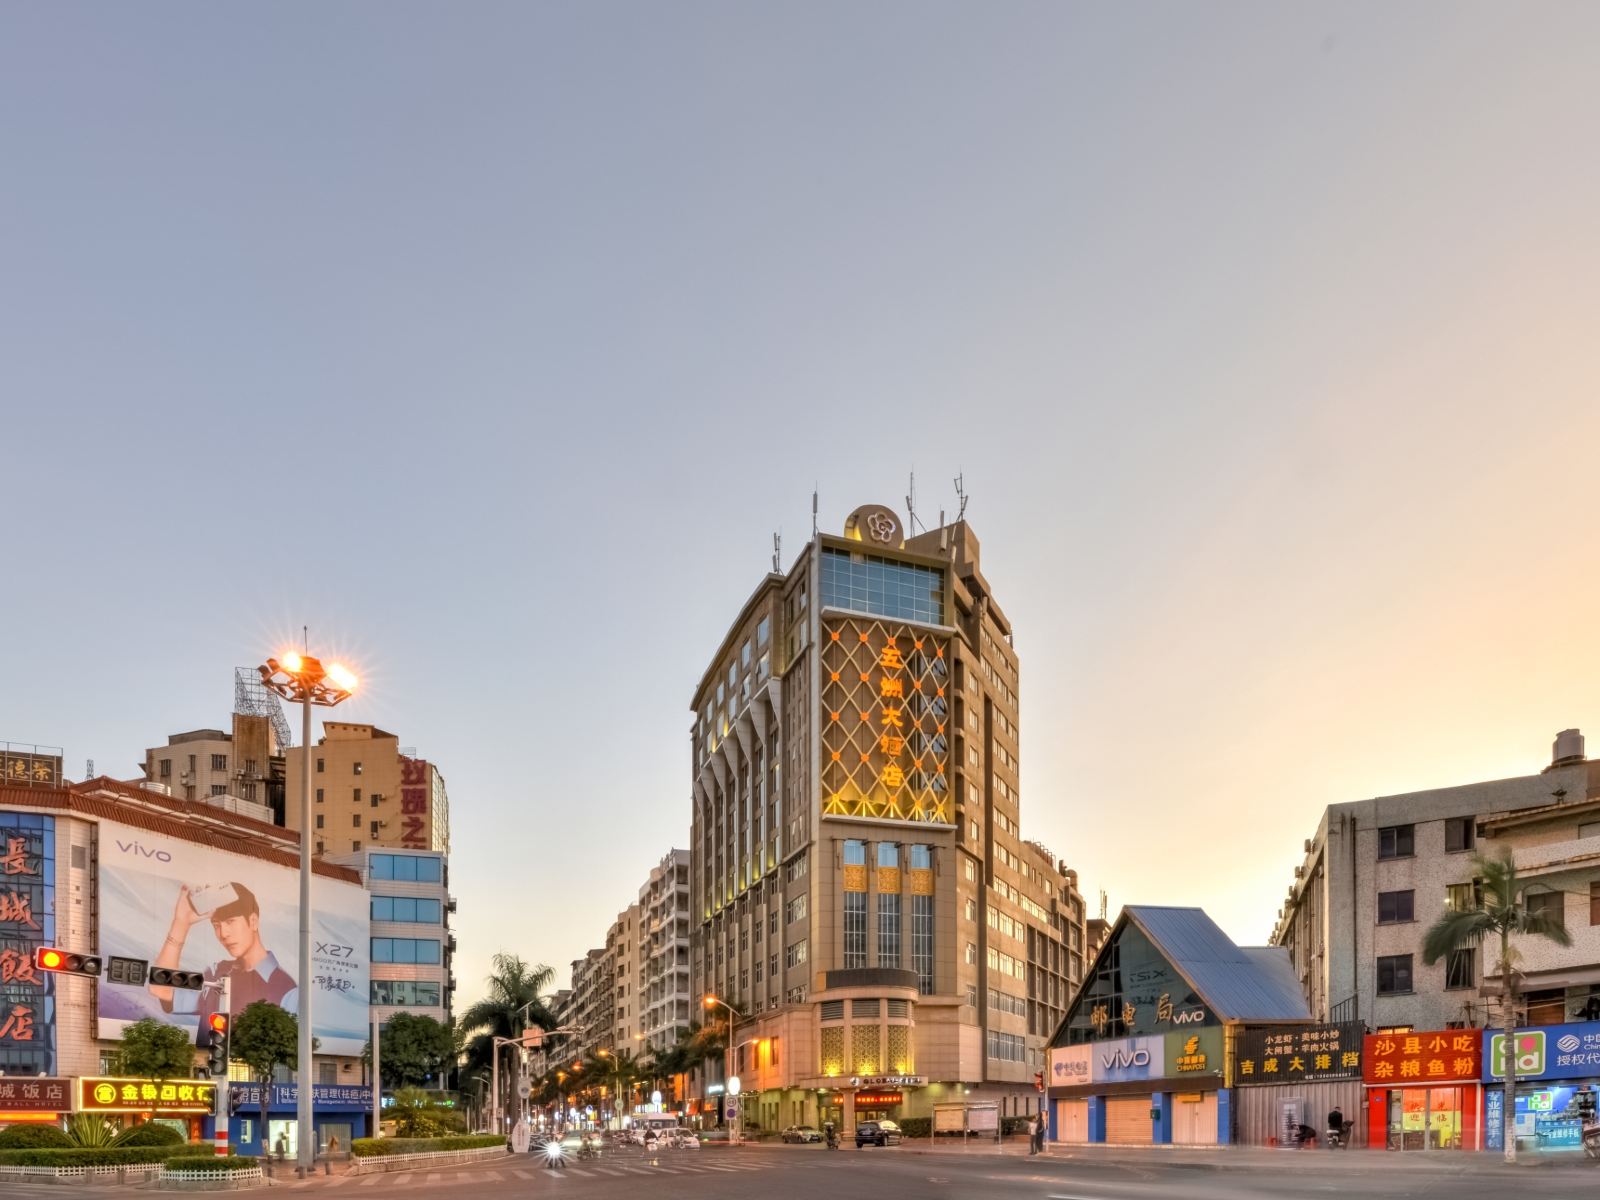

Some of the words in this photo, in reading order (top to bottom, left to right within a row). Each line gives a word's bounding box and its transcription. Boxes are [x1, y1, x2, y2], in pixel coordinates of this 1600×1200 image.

[880, 646, 904, 787] 五洲大酒店
[116, 840, 172, 863] vivo
[315, 941, 354, 959] X27
[1090, 992, 1174, 1034] 邮电局
[1172, 1010, 1205, 1025] vivo
[1374, 1035, 1475, 1056] 沙县小吃
[1102, 1050, 1149, 1069] vivo
[1240, 1051, 1360, 1075] 吉成大排档
[1374, 1057, 1475, 1078] 杂粮鱼粉
